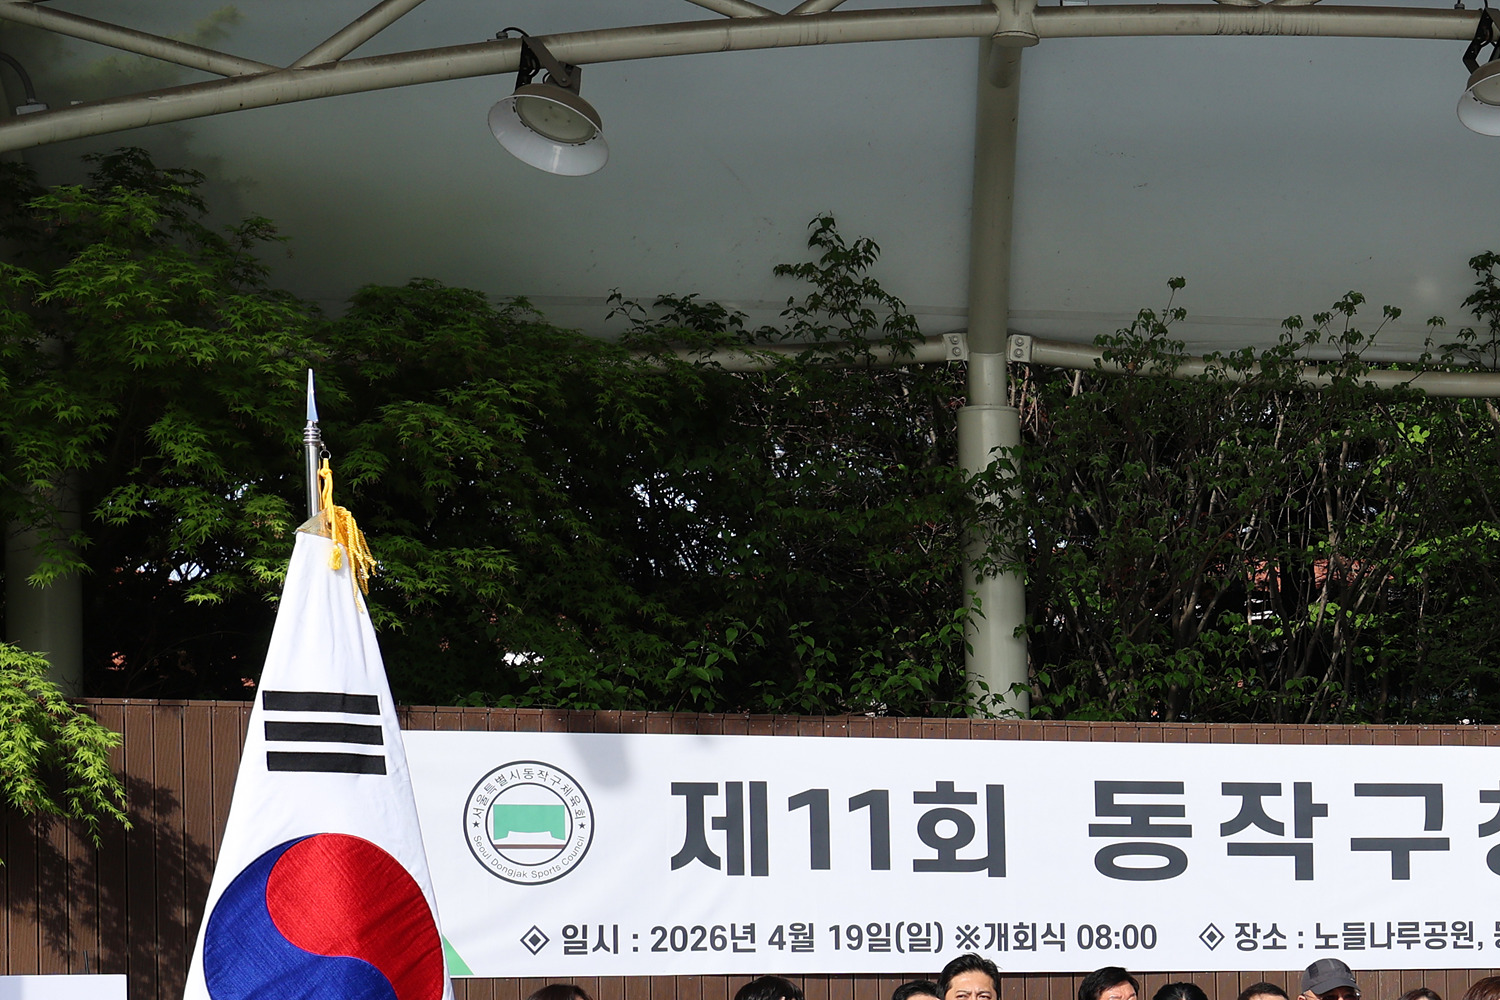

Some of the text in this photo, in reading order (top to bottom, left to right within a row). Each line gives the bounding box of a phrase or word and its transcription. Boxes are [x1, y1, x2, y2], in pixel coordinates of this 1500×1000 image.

[472, 767, 587, 820] 서울특별시동작구체육회
[670, 780, 1007, 878] 제11회
[473, 835, 586, 879] Seoul Dongjak Sports Council
[561, 924, 620, 956] 일시
[650, 922, 756, 953] 2026년
[768, 922, 815, 953] 4월
[829, 921, 944, 955] 19일(일)
[1077, 924, 1157, 951] 08:00
[1234, 922, 1287, 952] 장소
[1314, 920, 1483, 951] 노들나루공원,
